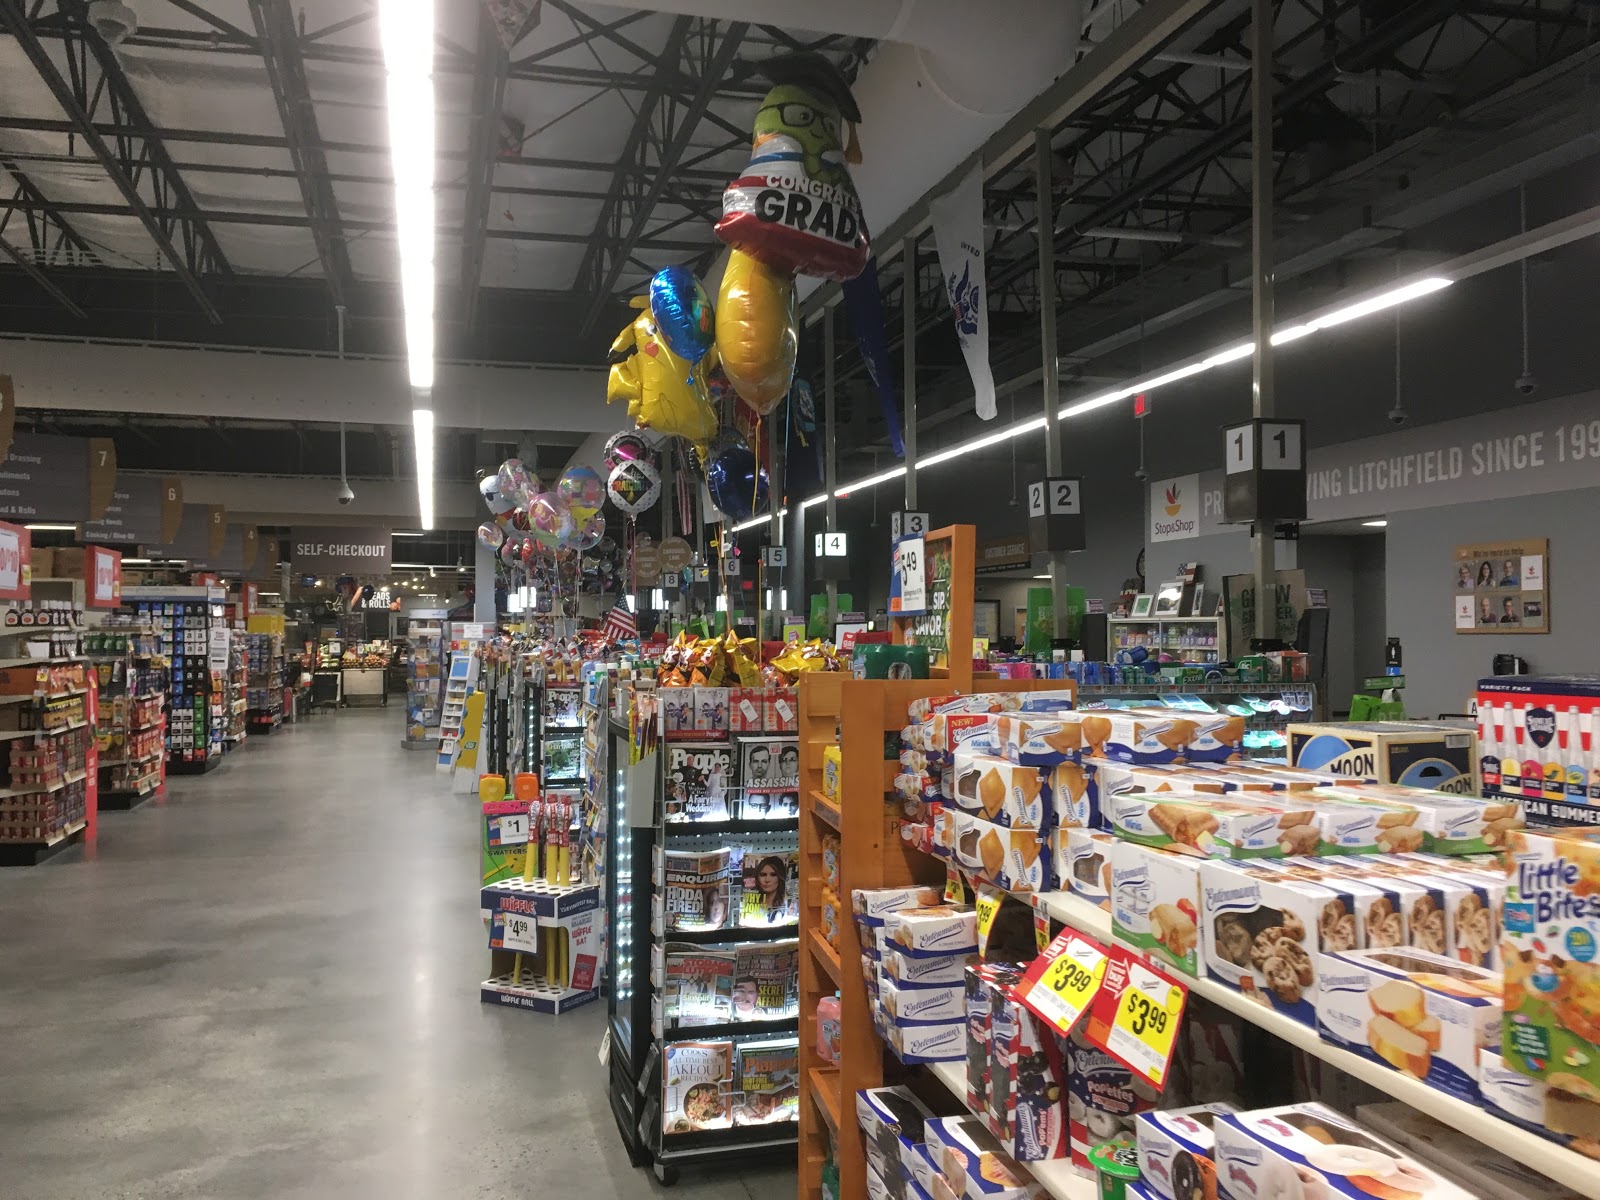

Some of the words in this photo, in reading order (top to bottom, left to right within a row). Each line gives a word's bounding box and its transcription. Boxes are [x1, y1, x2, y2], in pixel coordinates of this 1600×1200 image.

[766, 174, 858, 213] CONGRATS
[1234, 433, 1243, 461] 1
[1273, 430, 1286, 459] 1
[10, 454, 41, 465] Dressing
[98, 451, 107, 467] 7
[1349, 446, 1463, 495] LITCHFIELD
[1471, 431, 1544, 476] SINCE
[168, 488, 176, 501] 6
[1033, 487, 1041, 509] 2
[1057, 484, 1072, 506] 2
[19, 506, 37, 515] Rolls
[214, 512, 221, 523] 5
[893, 517, 899, 534] 3
[911, 516, 923, 532] 3
[1155, 519, 1194, 536] Stop&Shop
[248, 530, 254, 540] 4
[831, 537, 840, 549] 4
[297, 543, 386, 558] SELF-CHECKOUT
[774, 549, 782, 562] 5
[728, 561, 735, 571] 6
[668, 575, 675, 584] 8
[361, 600, 367, 608] &
[368, 600, 391, 609] ROLLS
[933, 592, 945, 610] SIP.
[915, 615, 944, 636] SAVOR.
[1183, 675, 1203, 685] Extra
[1480, 684, 1510, 692] VARIETY
[548, 690, 579, 703] People
[951, 718, 974, 727] NEW!
[971, 739, 992, 748] Minis
[671, 748, 730, 775] Pople
[1331, 753, 1375, 776] MOON
[746, 776, 799, 788] ASSASSINS
[1440, 777, 1472, 793] MOON
[507, 819, 520, 833] $1
[488, 848, 527, 857] SWATTERS
[666, 867, 729, 884] ENQUIRER
[1520, 858, 1577, 900] Little
[666, 886, 704, 901] HODA
[742, 893, 762, 904] WHY
[501, 896, 535, 914] WIFFLE
[666, 900, 704, 914] FIRED!
[870, 892, 910, 914] Entenmann's
[1538, 891, 1600, 923] Bites
[571, 925, 592, 939] WIFFLE
[920, 919, 966, 948] Entenmann's
[576, 937, 587, 946] BAT
[907, 954, 956, 980] Entenmann's
[759, 984, 784, 995] SECRET
[500, 995, 520, 1005] WIFFLE
[521, 997, 535, 1008] BALL
[757, 996, 784, 1008] AFFAIR
[904, 990, 954, 1017] Entenmann's
[911, 1026, 961, 1054] Entenmann's
[669, 1064, 724, 1076] TAKEOUT
